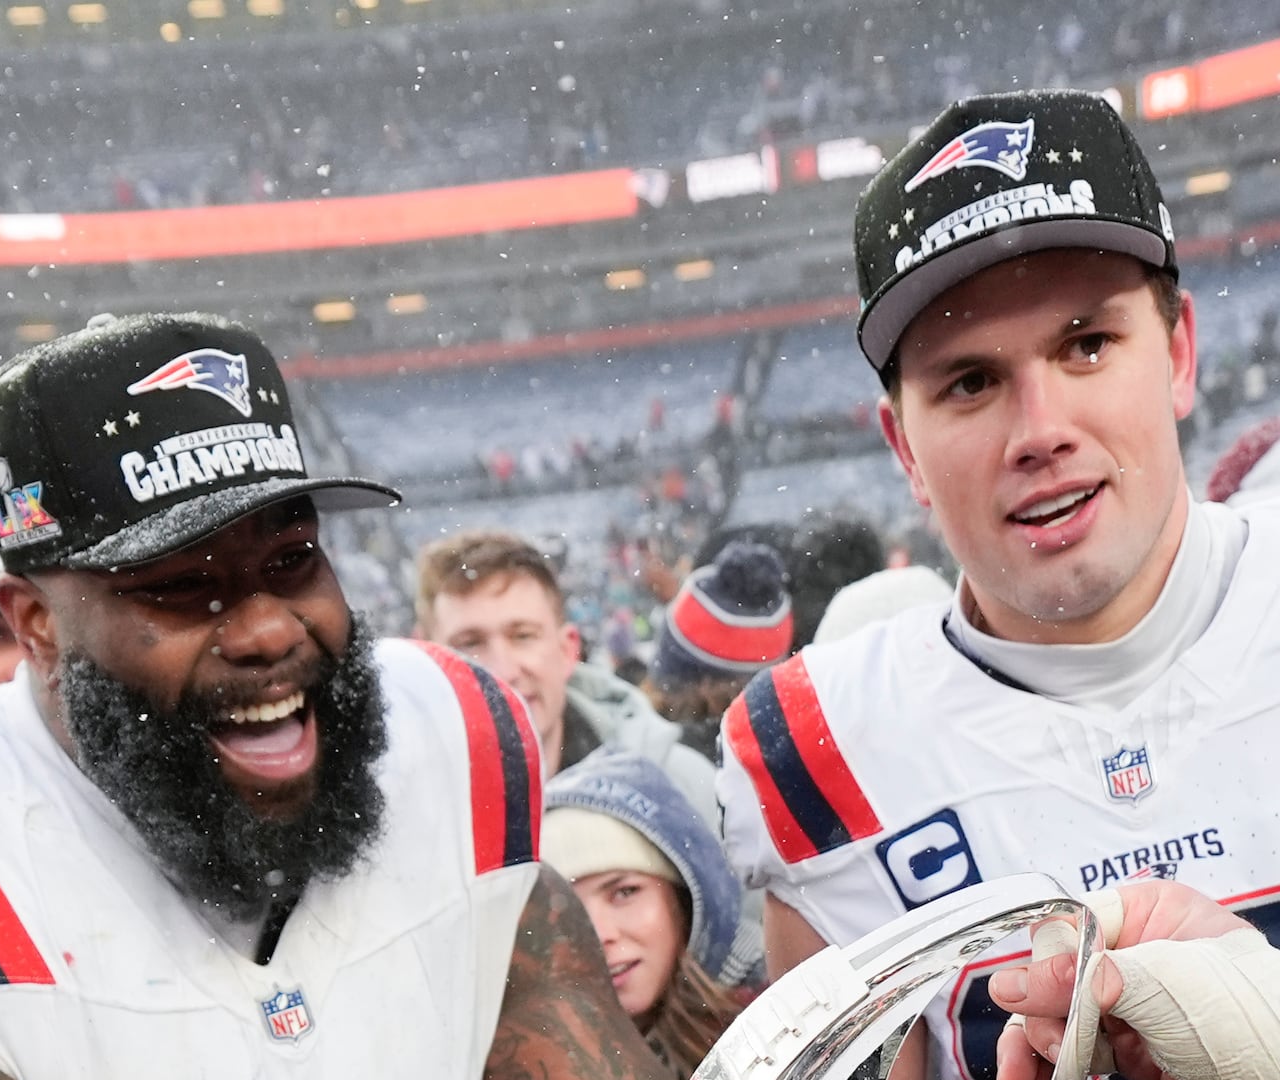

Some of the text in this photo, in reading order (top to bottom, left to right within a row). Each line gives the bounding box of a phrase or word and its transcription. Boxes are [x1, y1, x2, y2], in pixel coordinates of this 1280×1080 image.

[940, 189, 1029, 230] CONFERENCE
[178, 424, 258, 448] CONFERENCE
[1111, 766, 1148, 796] NFL
[886, 820, 970, 902] C
[1080, 828, 1225, 891] PATRIOTS
[271, 1009, 308, 1036] NFL
